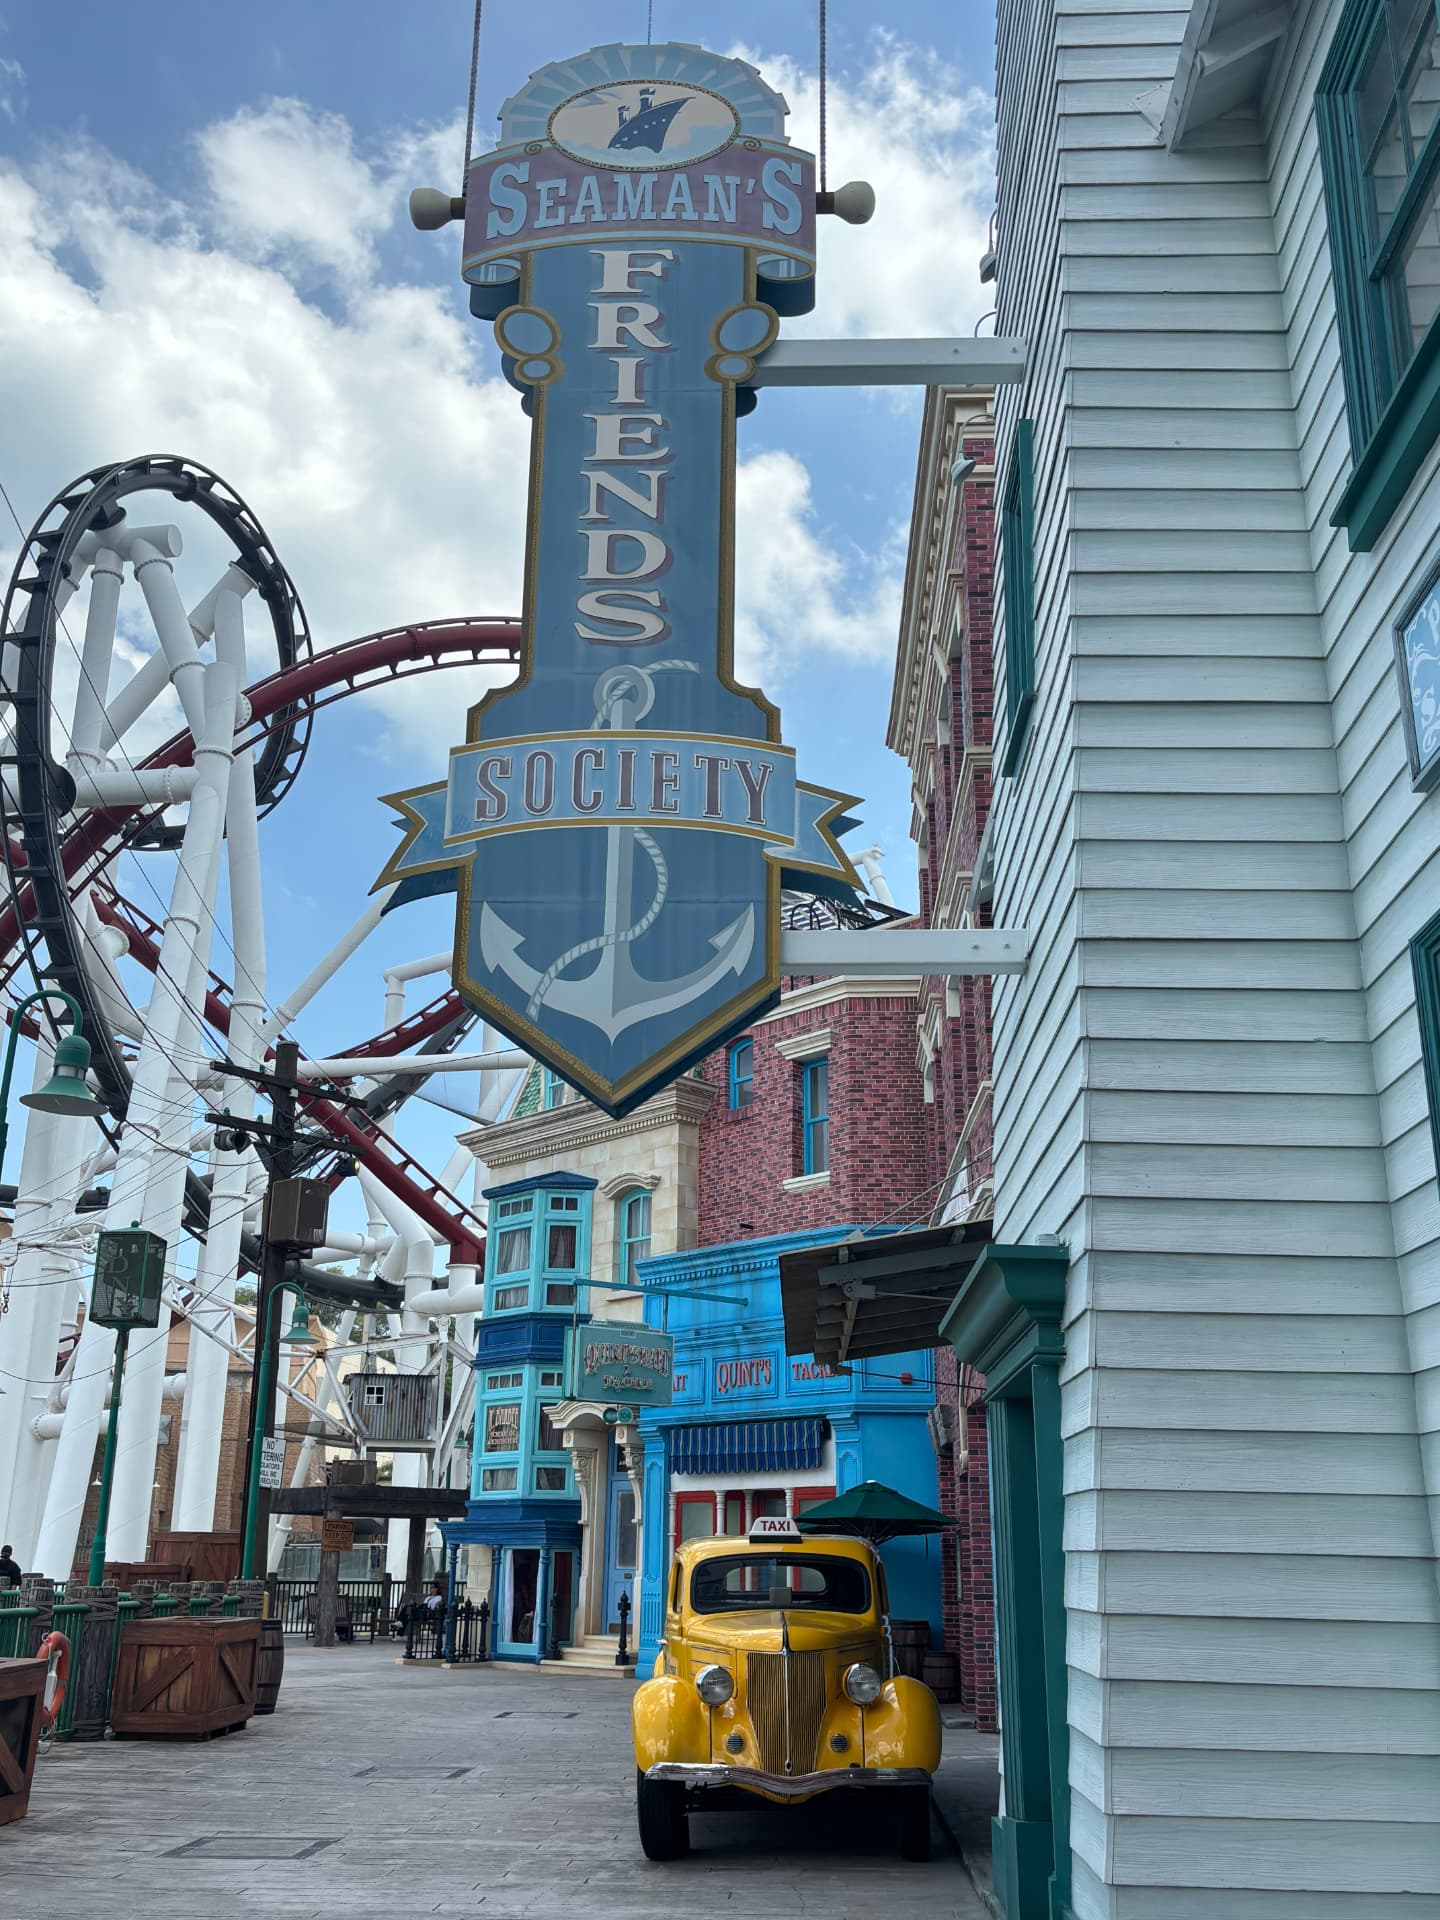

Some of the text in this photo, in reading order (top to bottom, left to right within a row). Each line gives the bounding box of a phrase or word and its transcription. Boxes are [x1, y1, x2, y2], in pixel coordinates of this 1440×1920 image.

[486, 158, 803, 240] SEAMAN'S
[574, 249, 675, 642] FRIENDS
[474, 747, 774, 825] SOCIETY
[717, 1358, 771, 1394] QUINT'S
[792, 1360, 837, 1381] TACKL
[262, 1451, 284, 1463] TERING
[760, 1520, 791, 1532] TAXI
